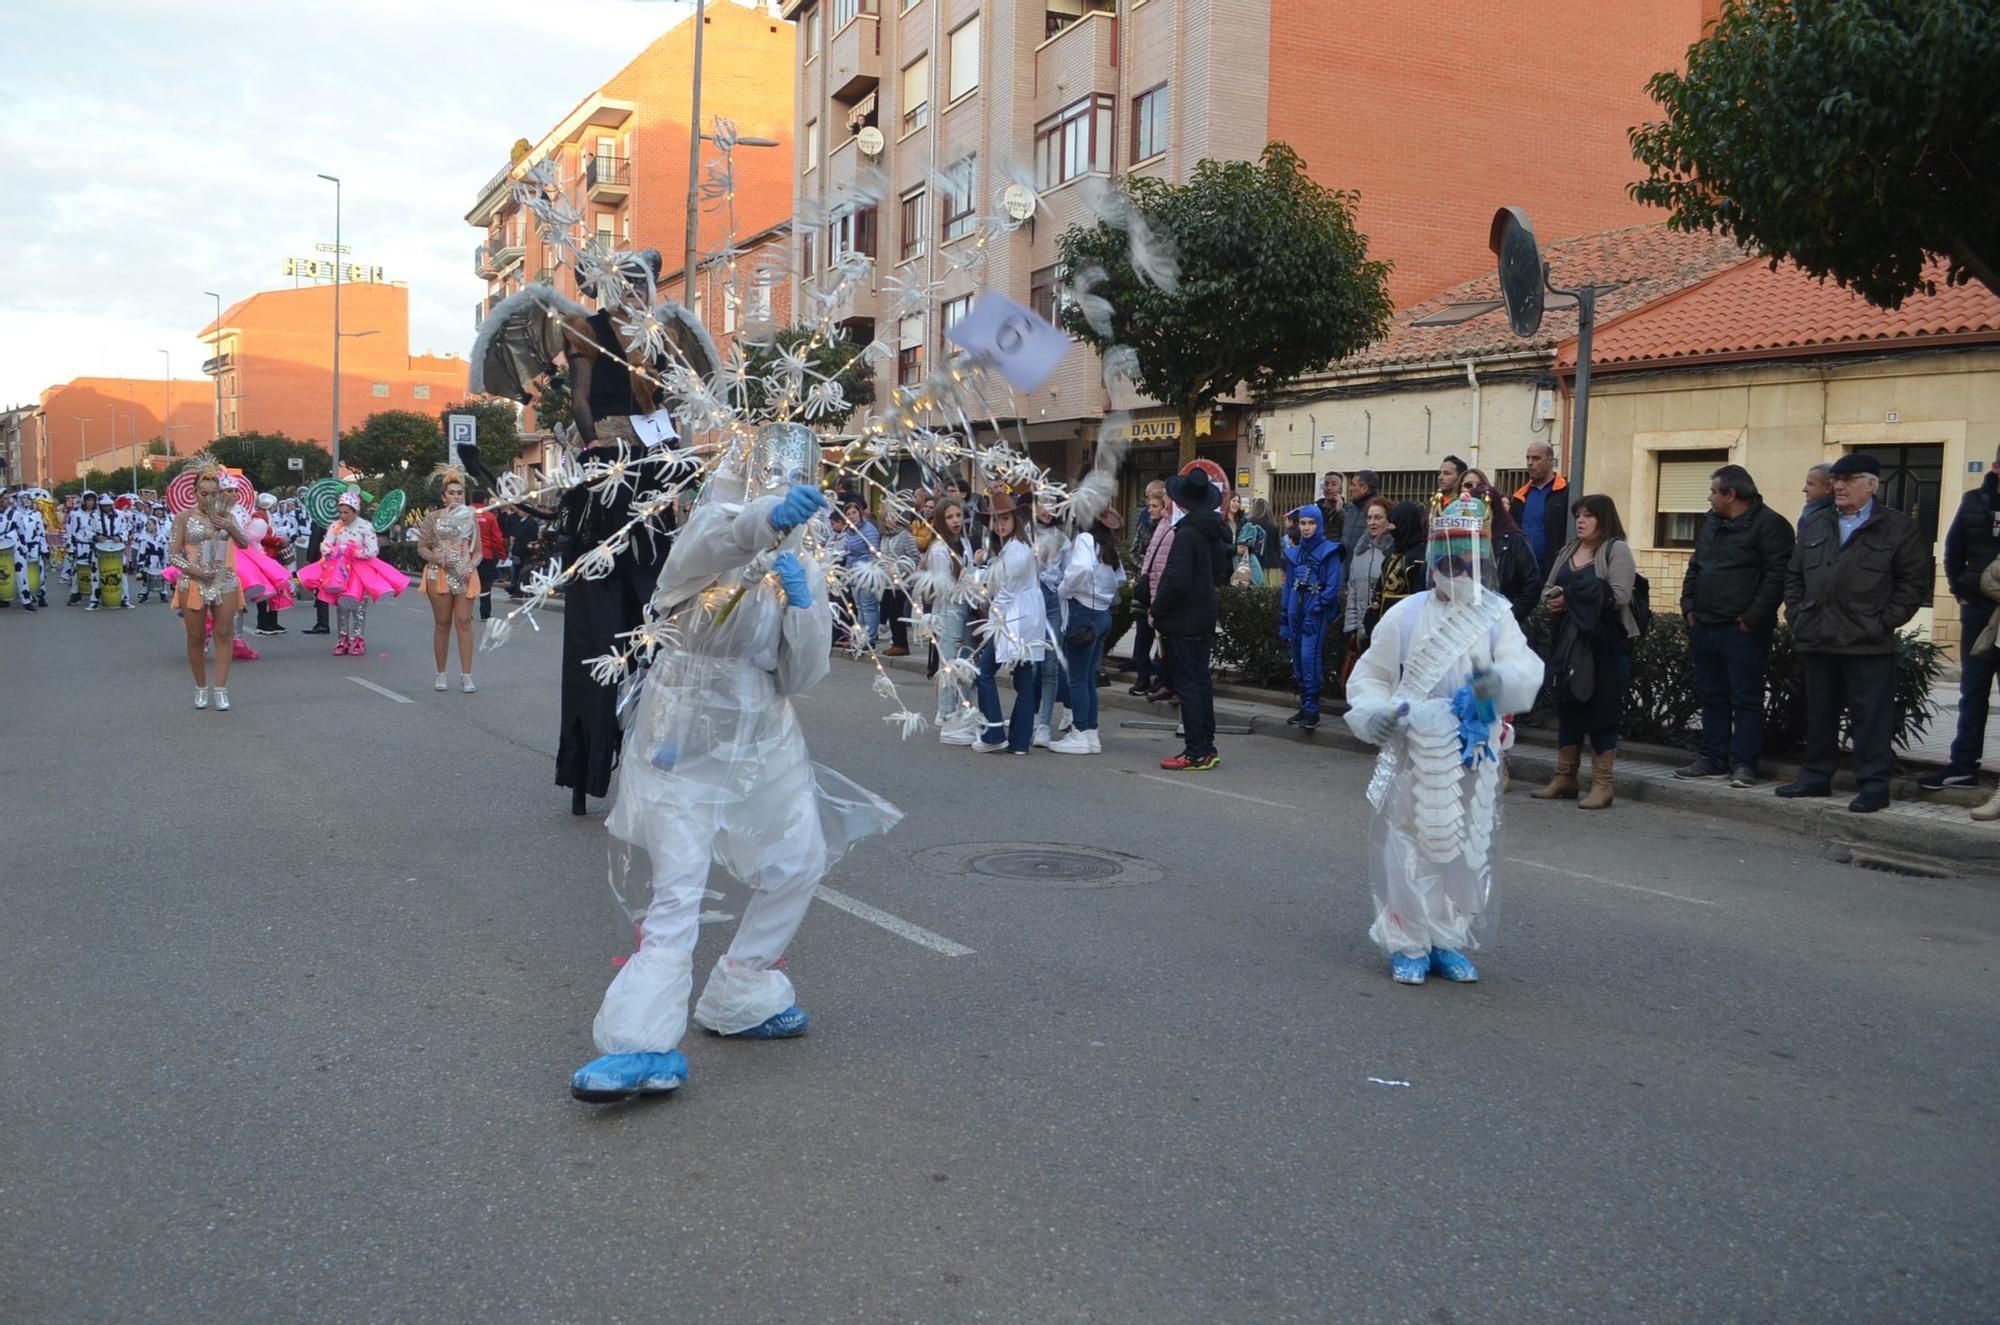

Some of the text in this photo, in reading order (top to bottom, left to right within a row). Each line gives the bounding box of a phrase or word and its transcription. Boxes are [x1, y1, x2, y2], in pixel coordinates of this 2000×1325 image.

[283, 257, 384, 284] HOTEL
[455, 424, 469, 440] P
[1132, 422, 1176, 436] DAVID
